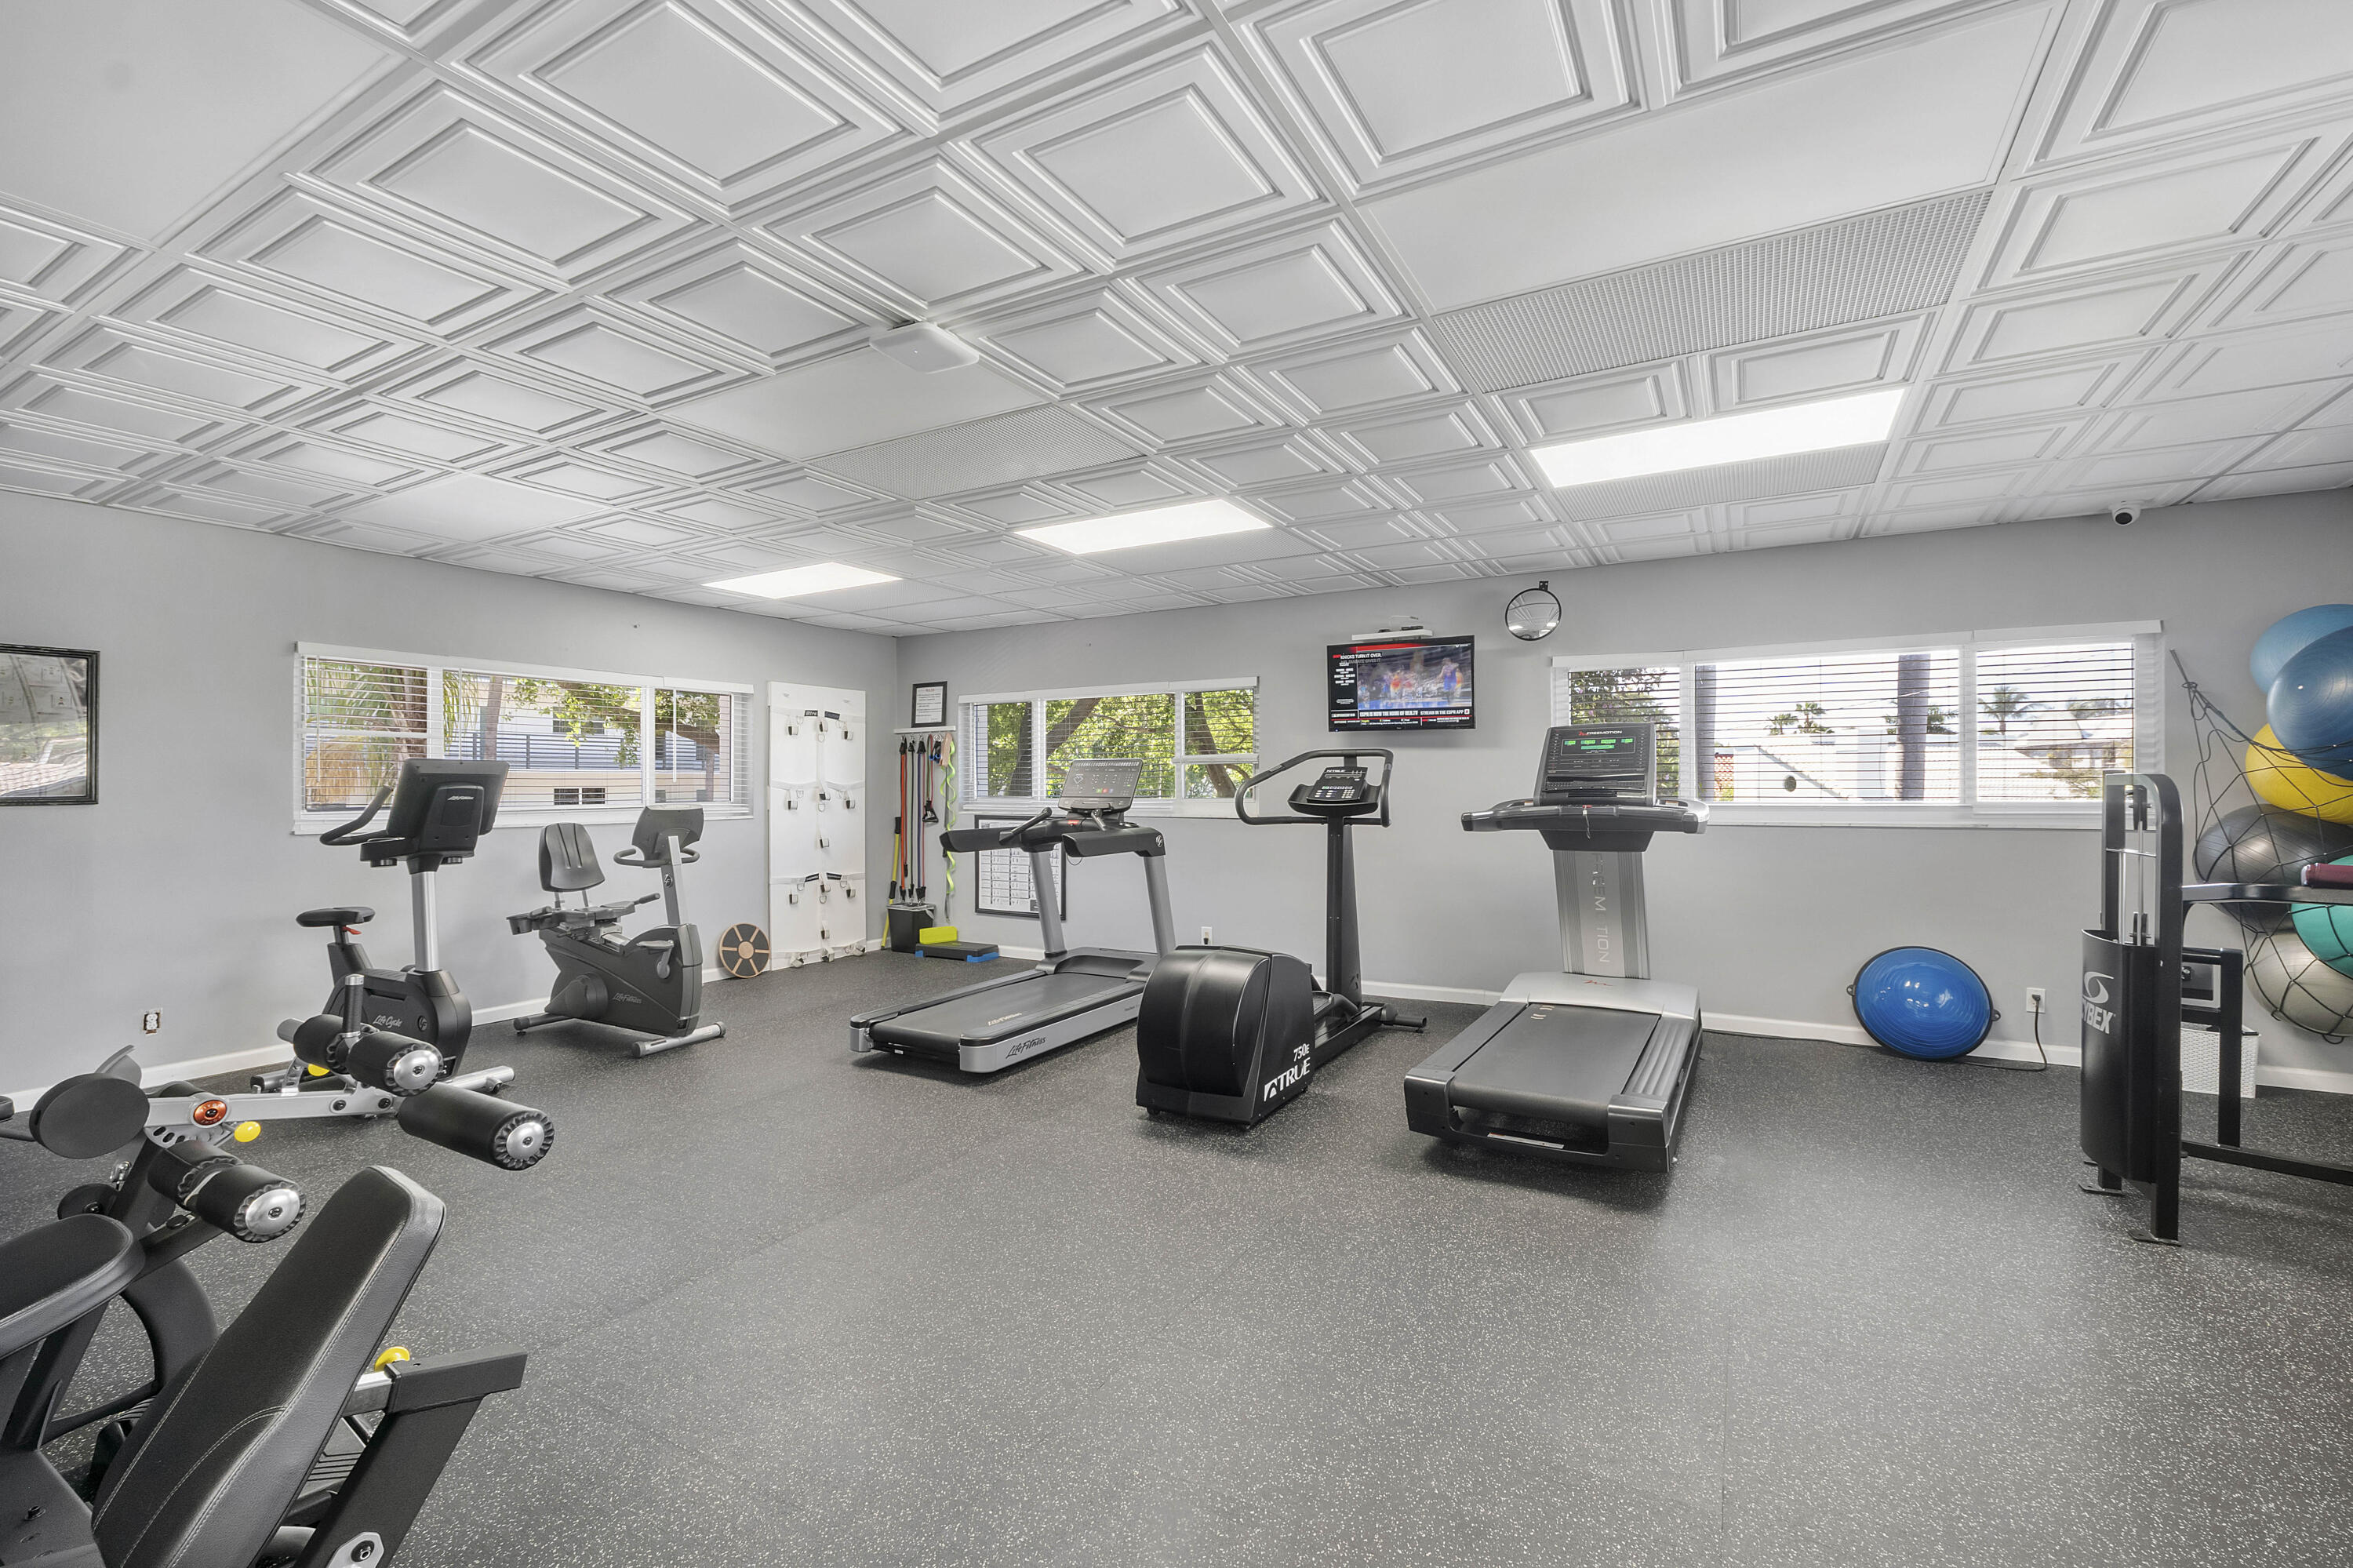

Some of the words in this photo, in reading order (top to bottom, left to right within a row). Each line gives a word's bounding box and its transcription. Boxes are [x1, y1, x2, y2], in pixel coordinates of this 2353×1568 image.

[2082, 997, 2114, 1035] YBEX
[1293, 1043, 1310, 1062] 750E
[1277, 1057, 1311, 1092] TRUE
